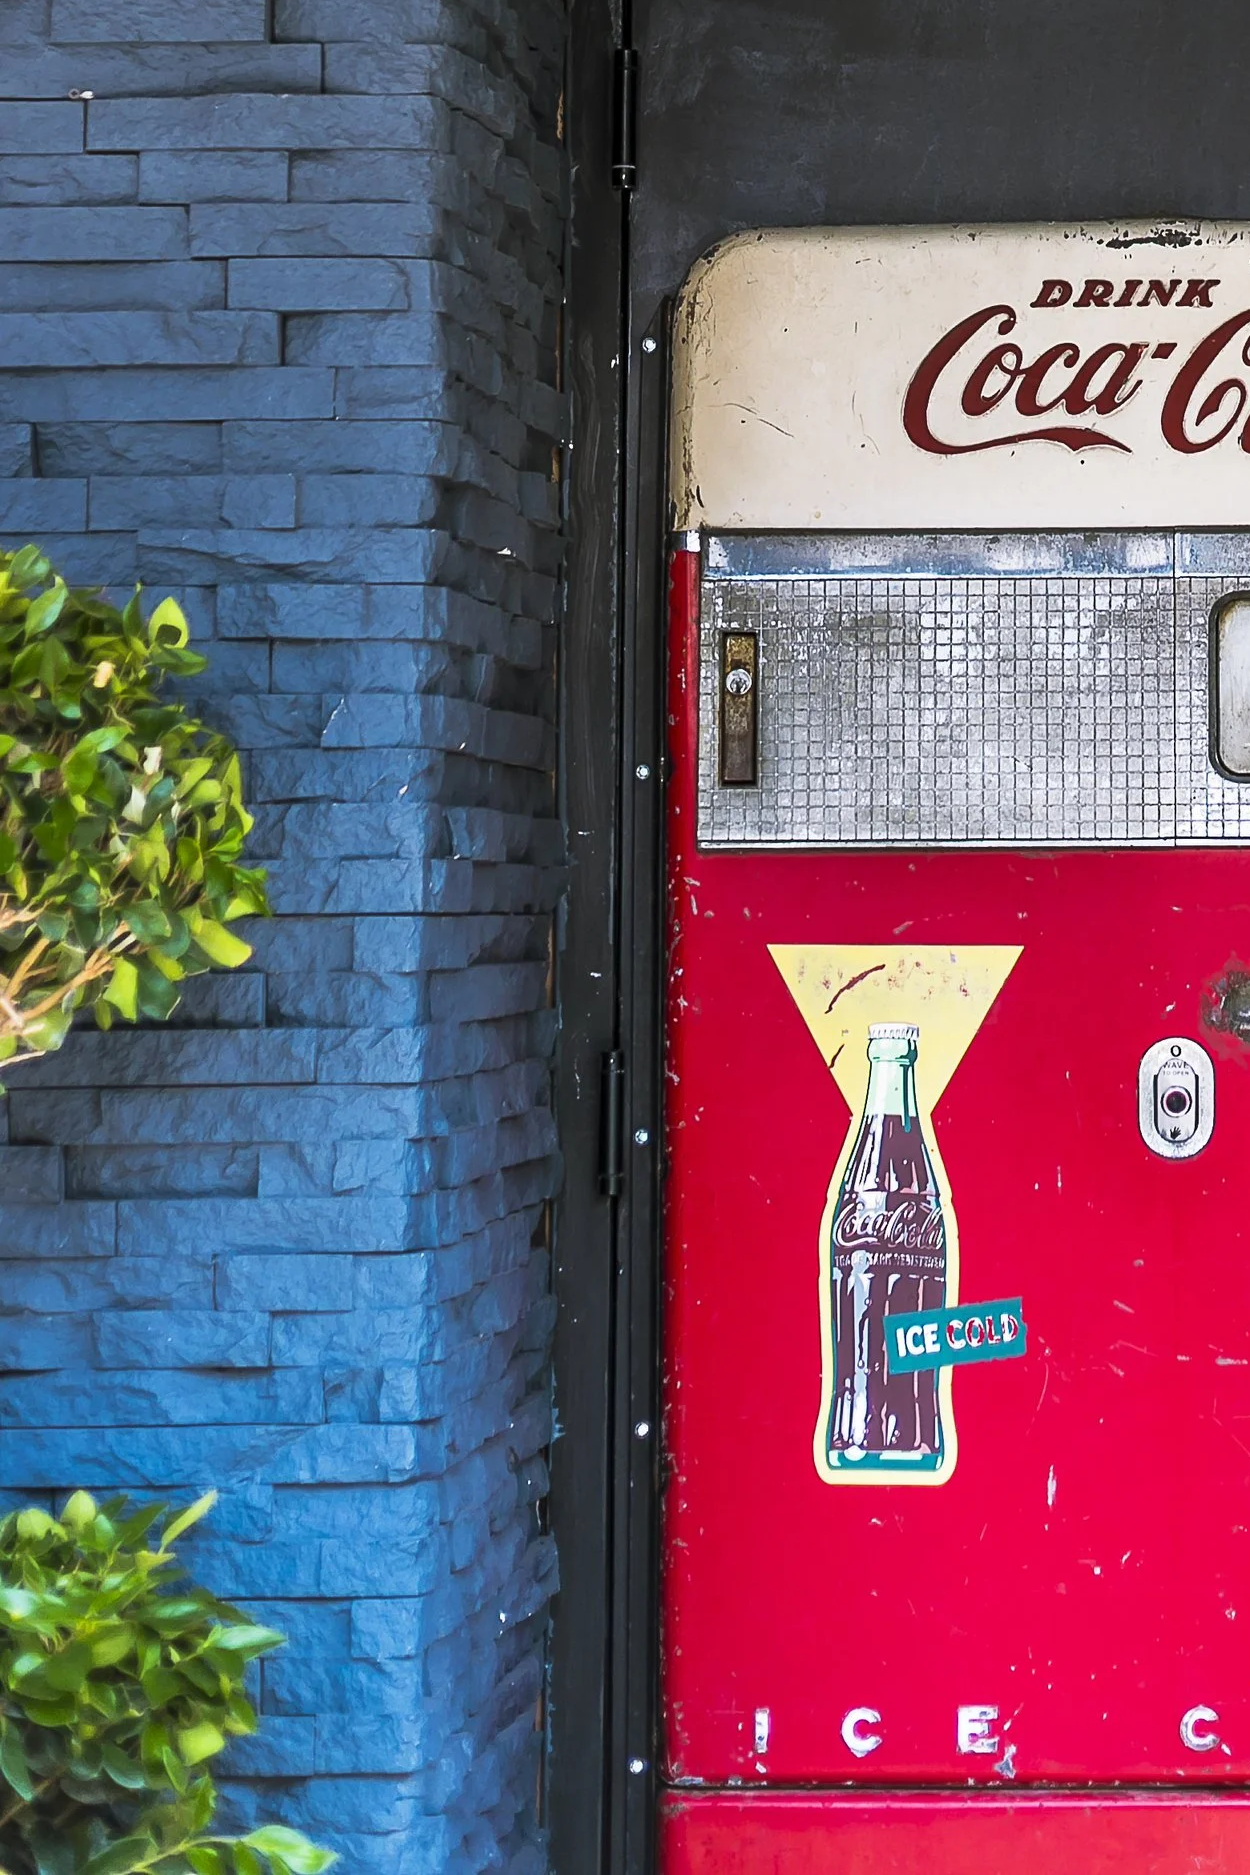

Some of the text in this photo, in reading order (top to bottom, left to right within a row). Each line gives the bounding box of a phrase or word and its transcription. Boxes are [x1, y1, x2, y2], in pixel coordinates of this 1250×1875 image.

[1030, 279, 1220, 309] DRINK
[1163, 1061, 1189, 1069] WAVE
[896, 1313, 1019, 1358] ICE COLD
[752, 1704, 1000, 1759] ICE
